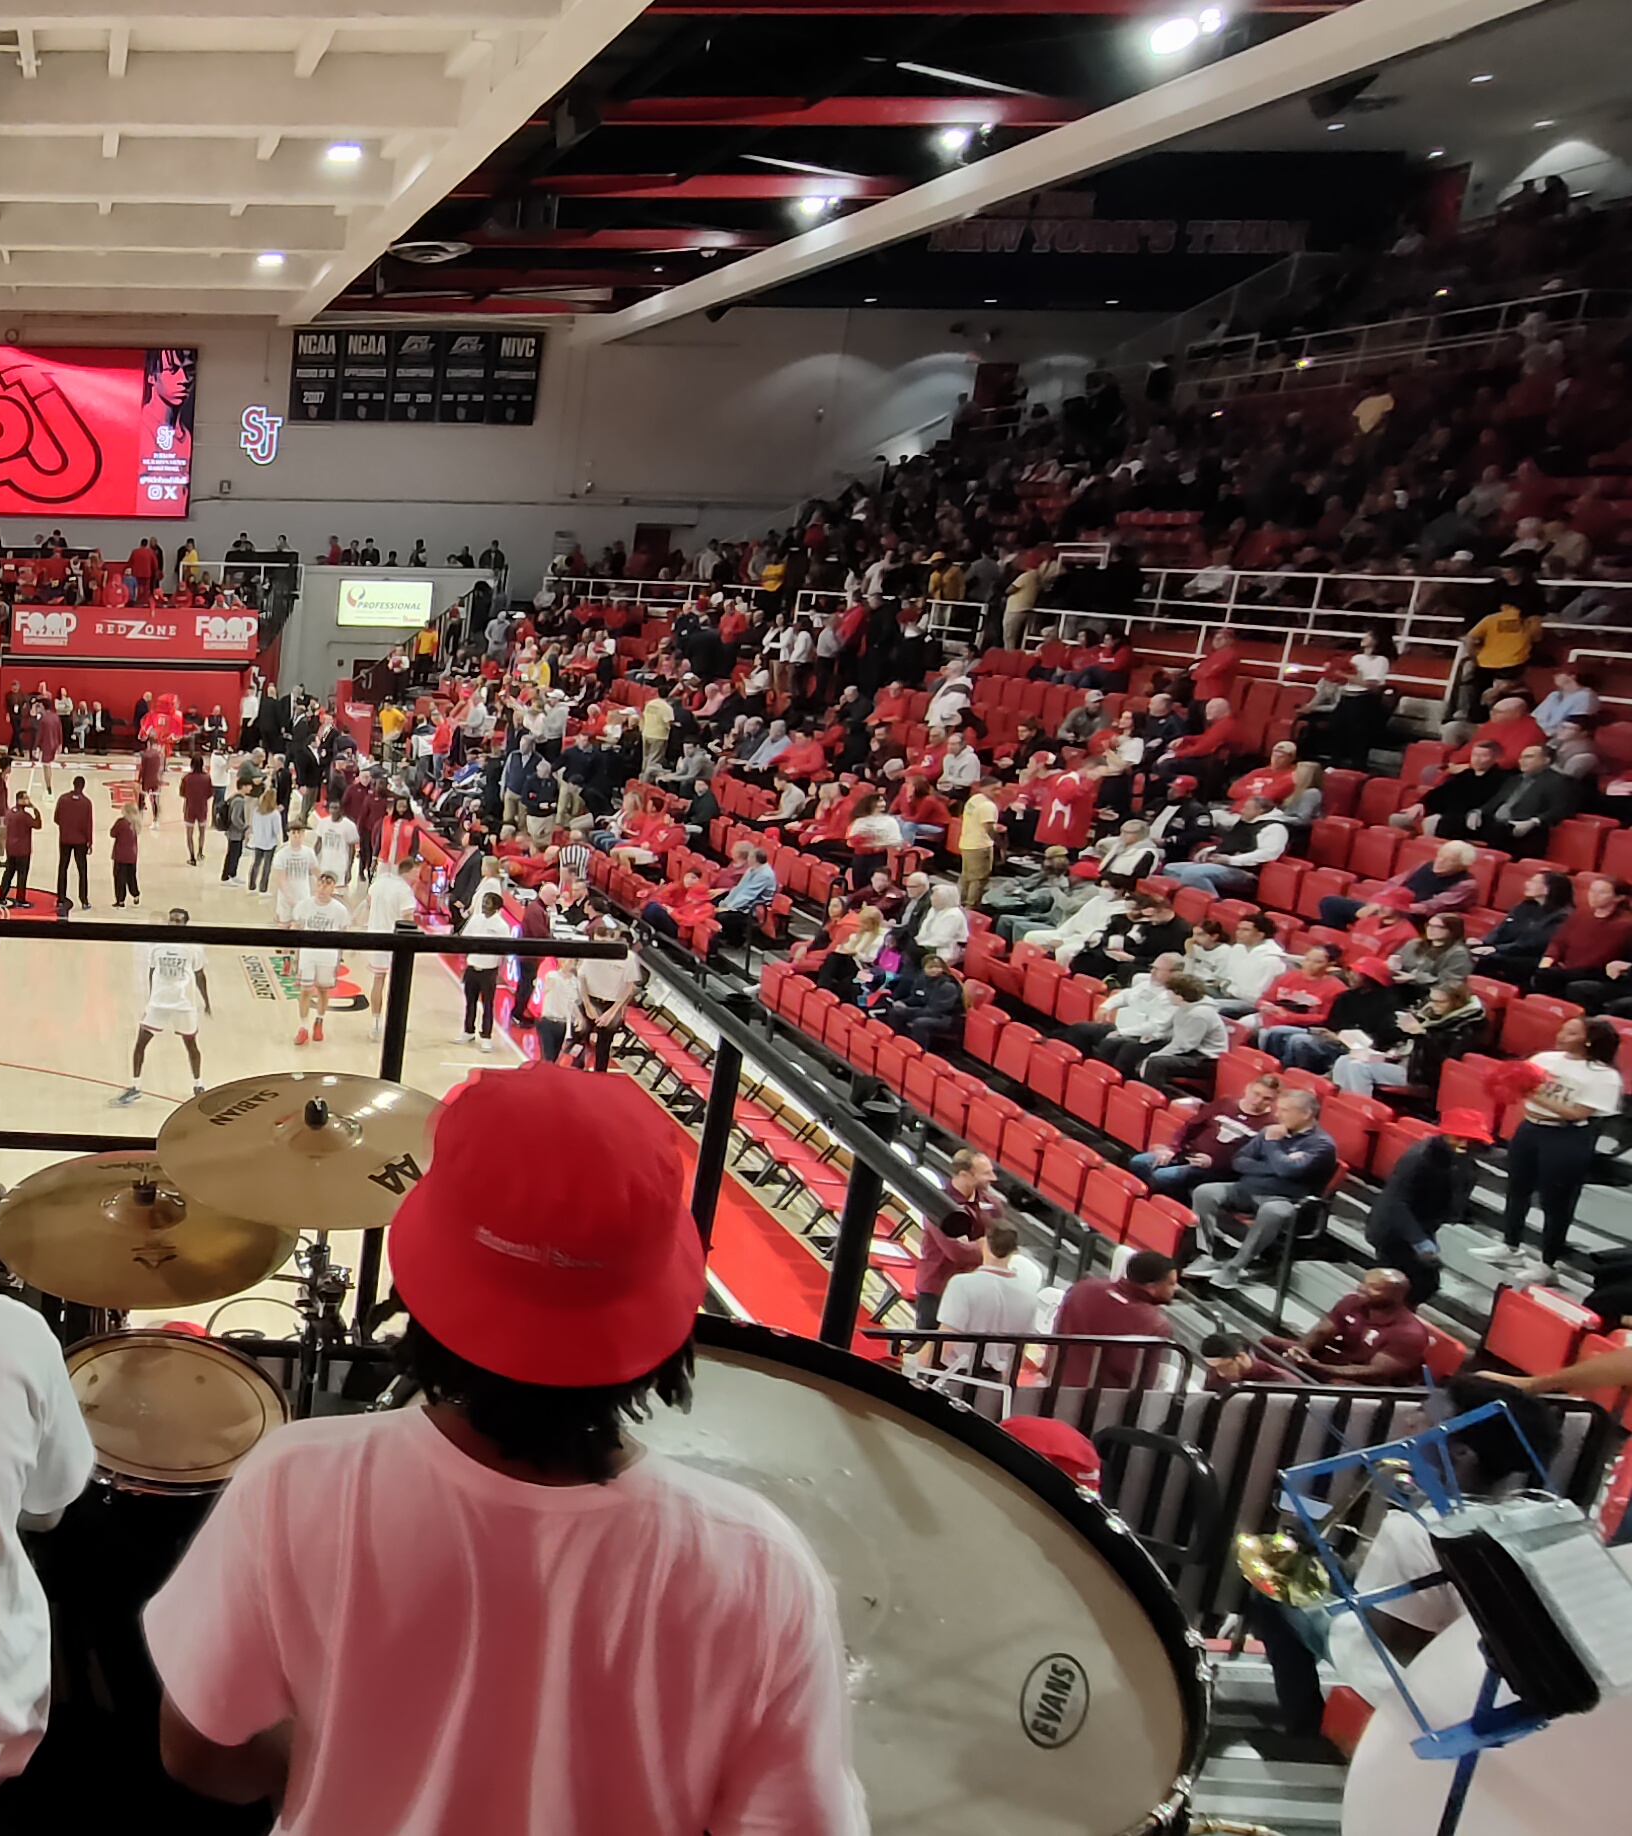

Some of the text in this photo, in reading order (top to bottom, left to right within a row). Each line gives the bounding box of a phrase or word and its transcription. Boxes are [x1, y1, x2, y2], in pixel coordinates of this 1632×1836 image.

[298, 334, 336, 355] NCAA
[348, 334, 386, 355] NCAA
[500, 337, 536, 357] NIVC
[357, 601, 421, 610] PROFESSIONAL
[15, 611, 77, 633] FOOD
[195, 615, 259, 637] FOOD
[209, 1089, 279, 1126] SABIAN
[1031, 1663, 1076, 1740] EVANS
